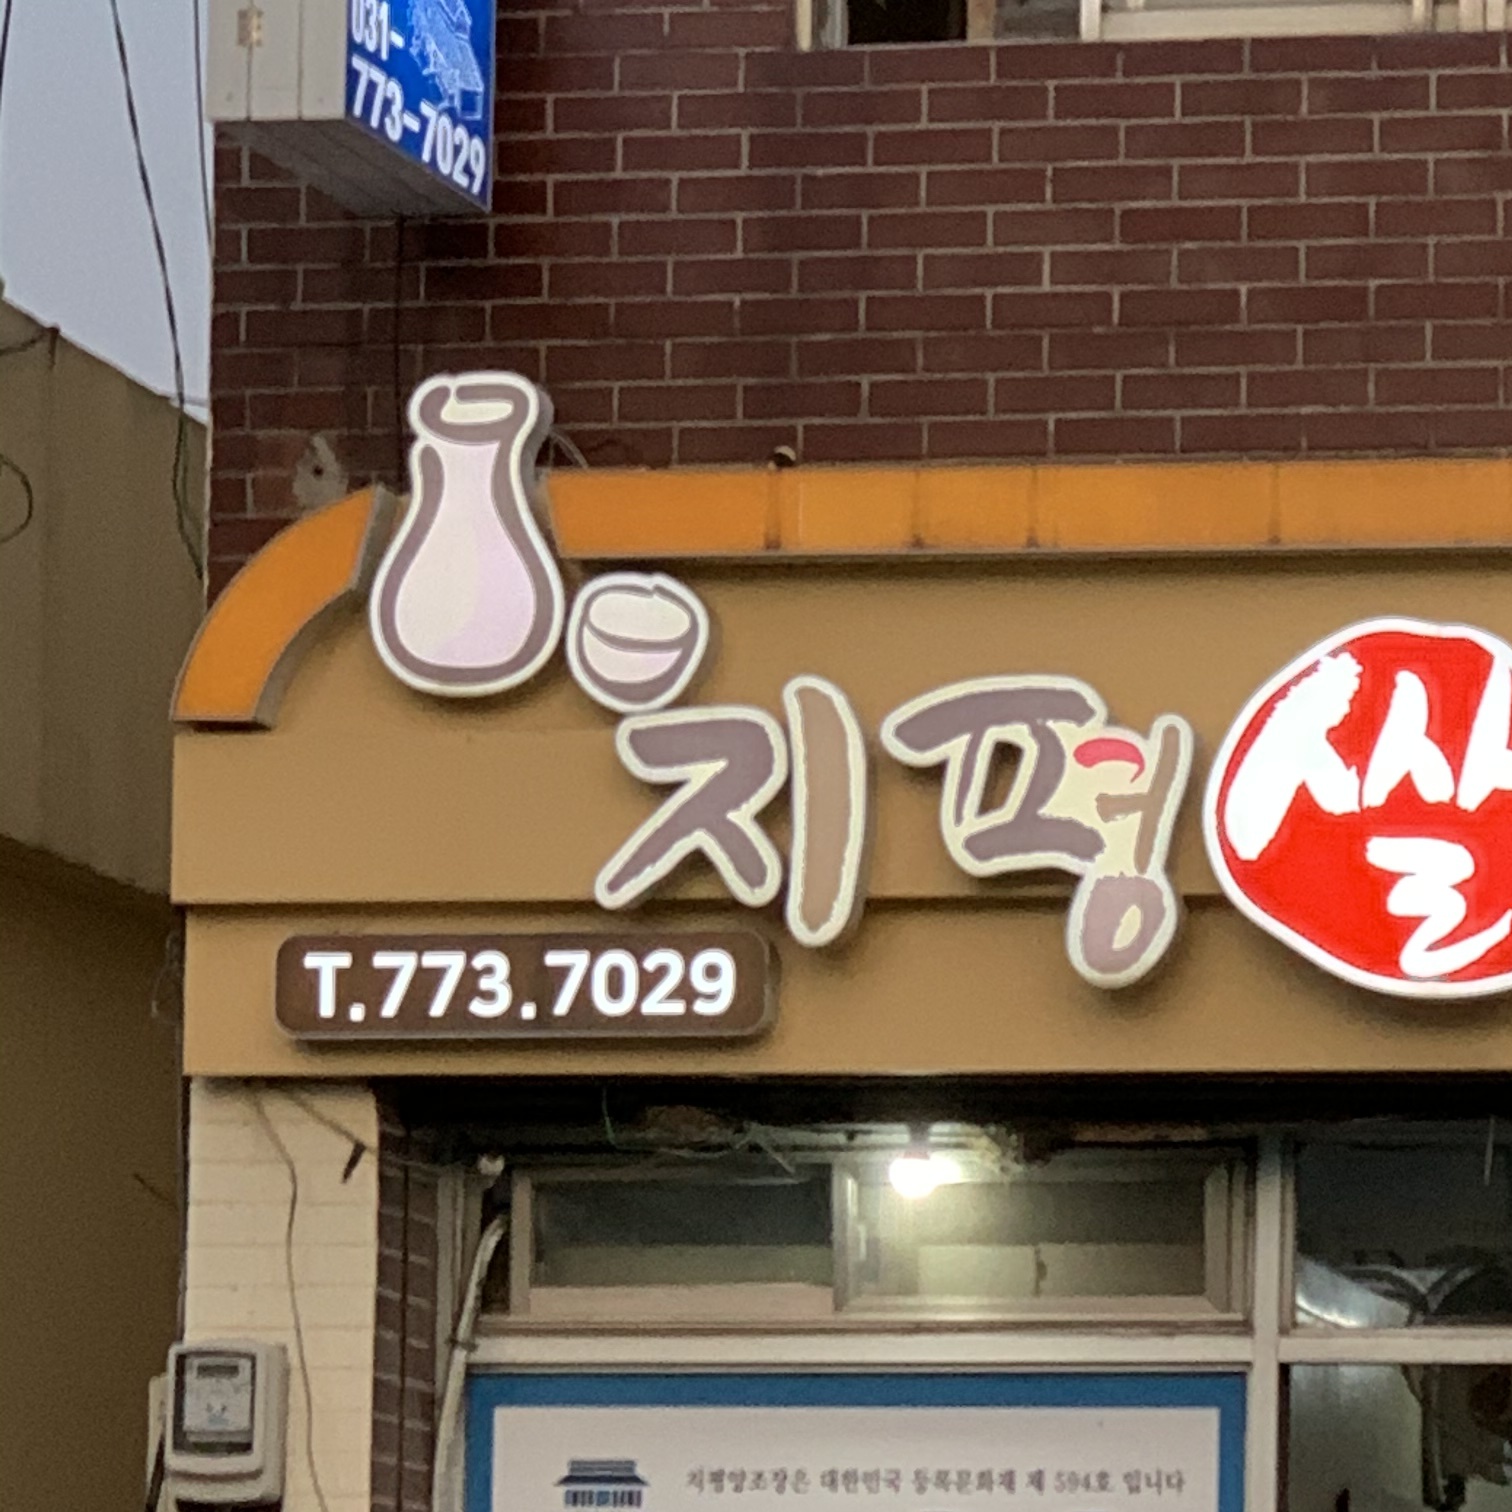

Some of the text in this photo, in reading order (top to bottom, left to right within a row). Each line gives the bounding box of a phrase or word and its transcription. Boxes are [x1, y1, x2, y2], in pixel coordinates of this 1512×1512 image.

[351, 0, 405, 61] 031-
[352, 54, 486, 195] 773-7029
[596, 674, 1194, 988] 지평
[303, 948, 738, 1021] T.773.7029
[1122, 1468, 1186, 1496] 입니다
